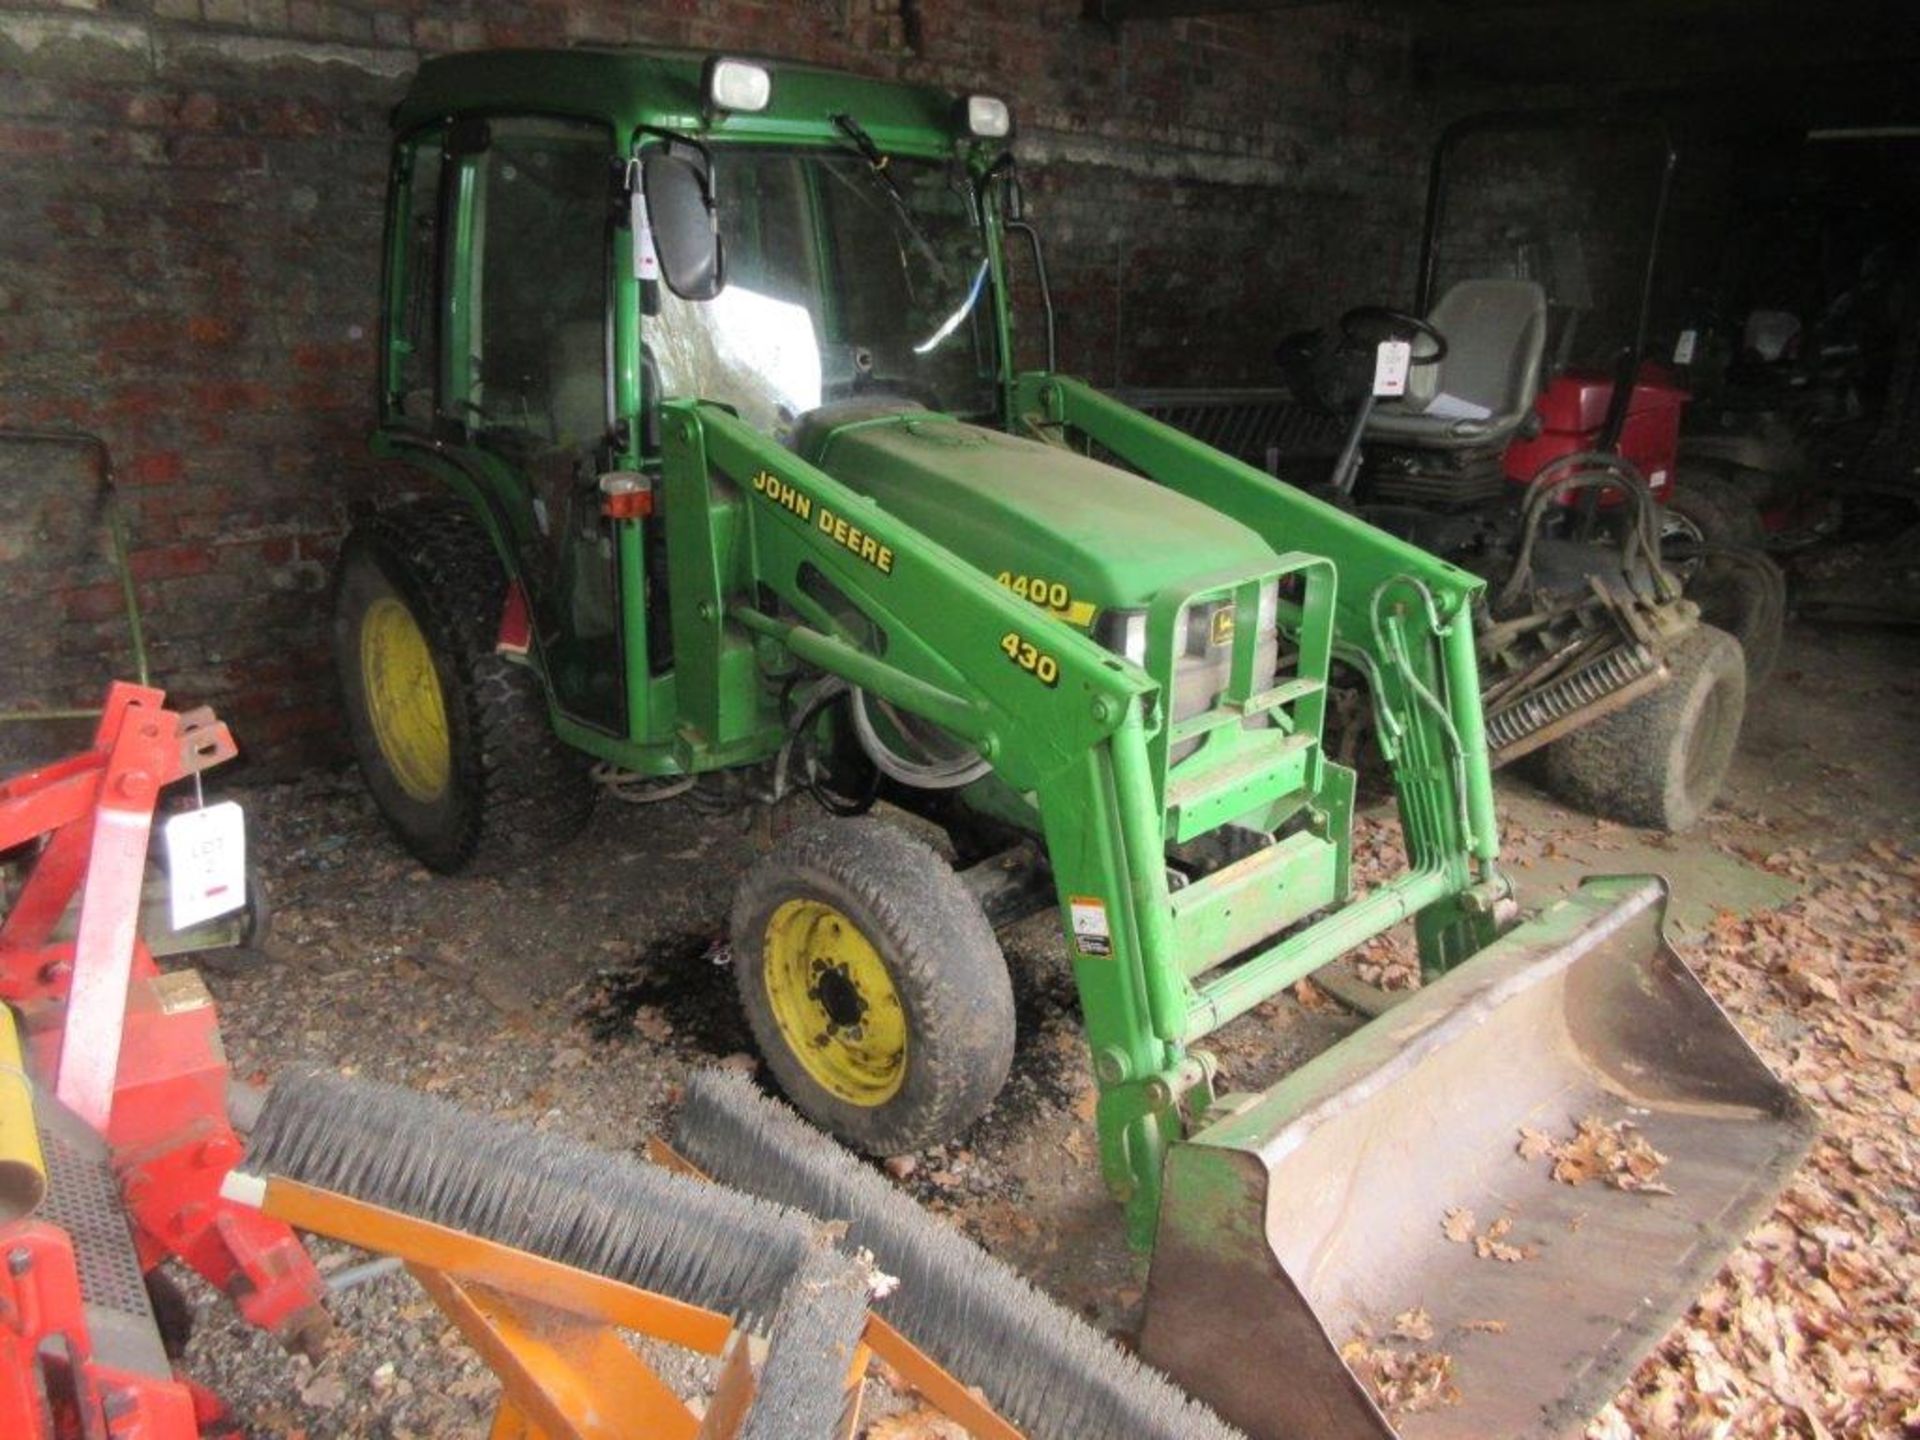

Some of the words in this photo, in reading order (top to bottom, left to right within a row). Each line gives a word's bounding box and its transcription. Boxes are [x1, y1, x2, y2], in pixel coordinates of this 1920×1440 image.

[753, 470, 812, 520] JOHN
[818, 508, 893, 574] DEERE
[997, 571, 1068, 609] 4400
[1001, 633, 1057, 683] 430
